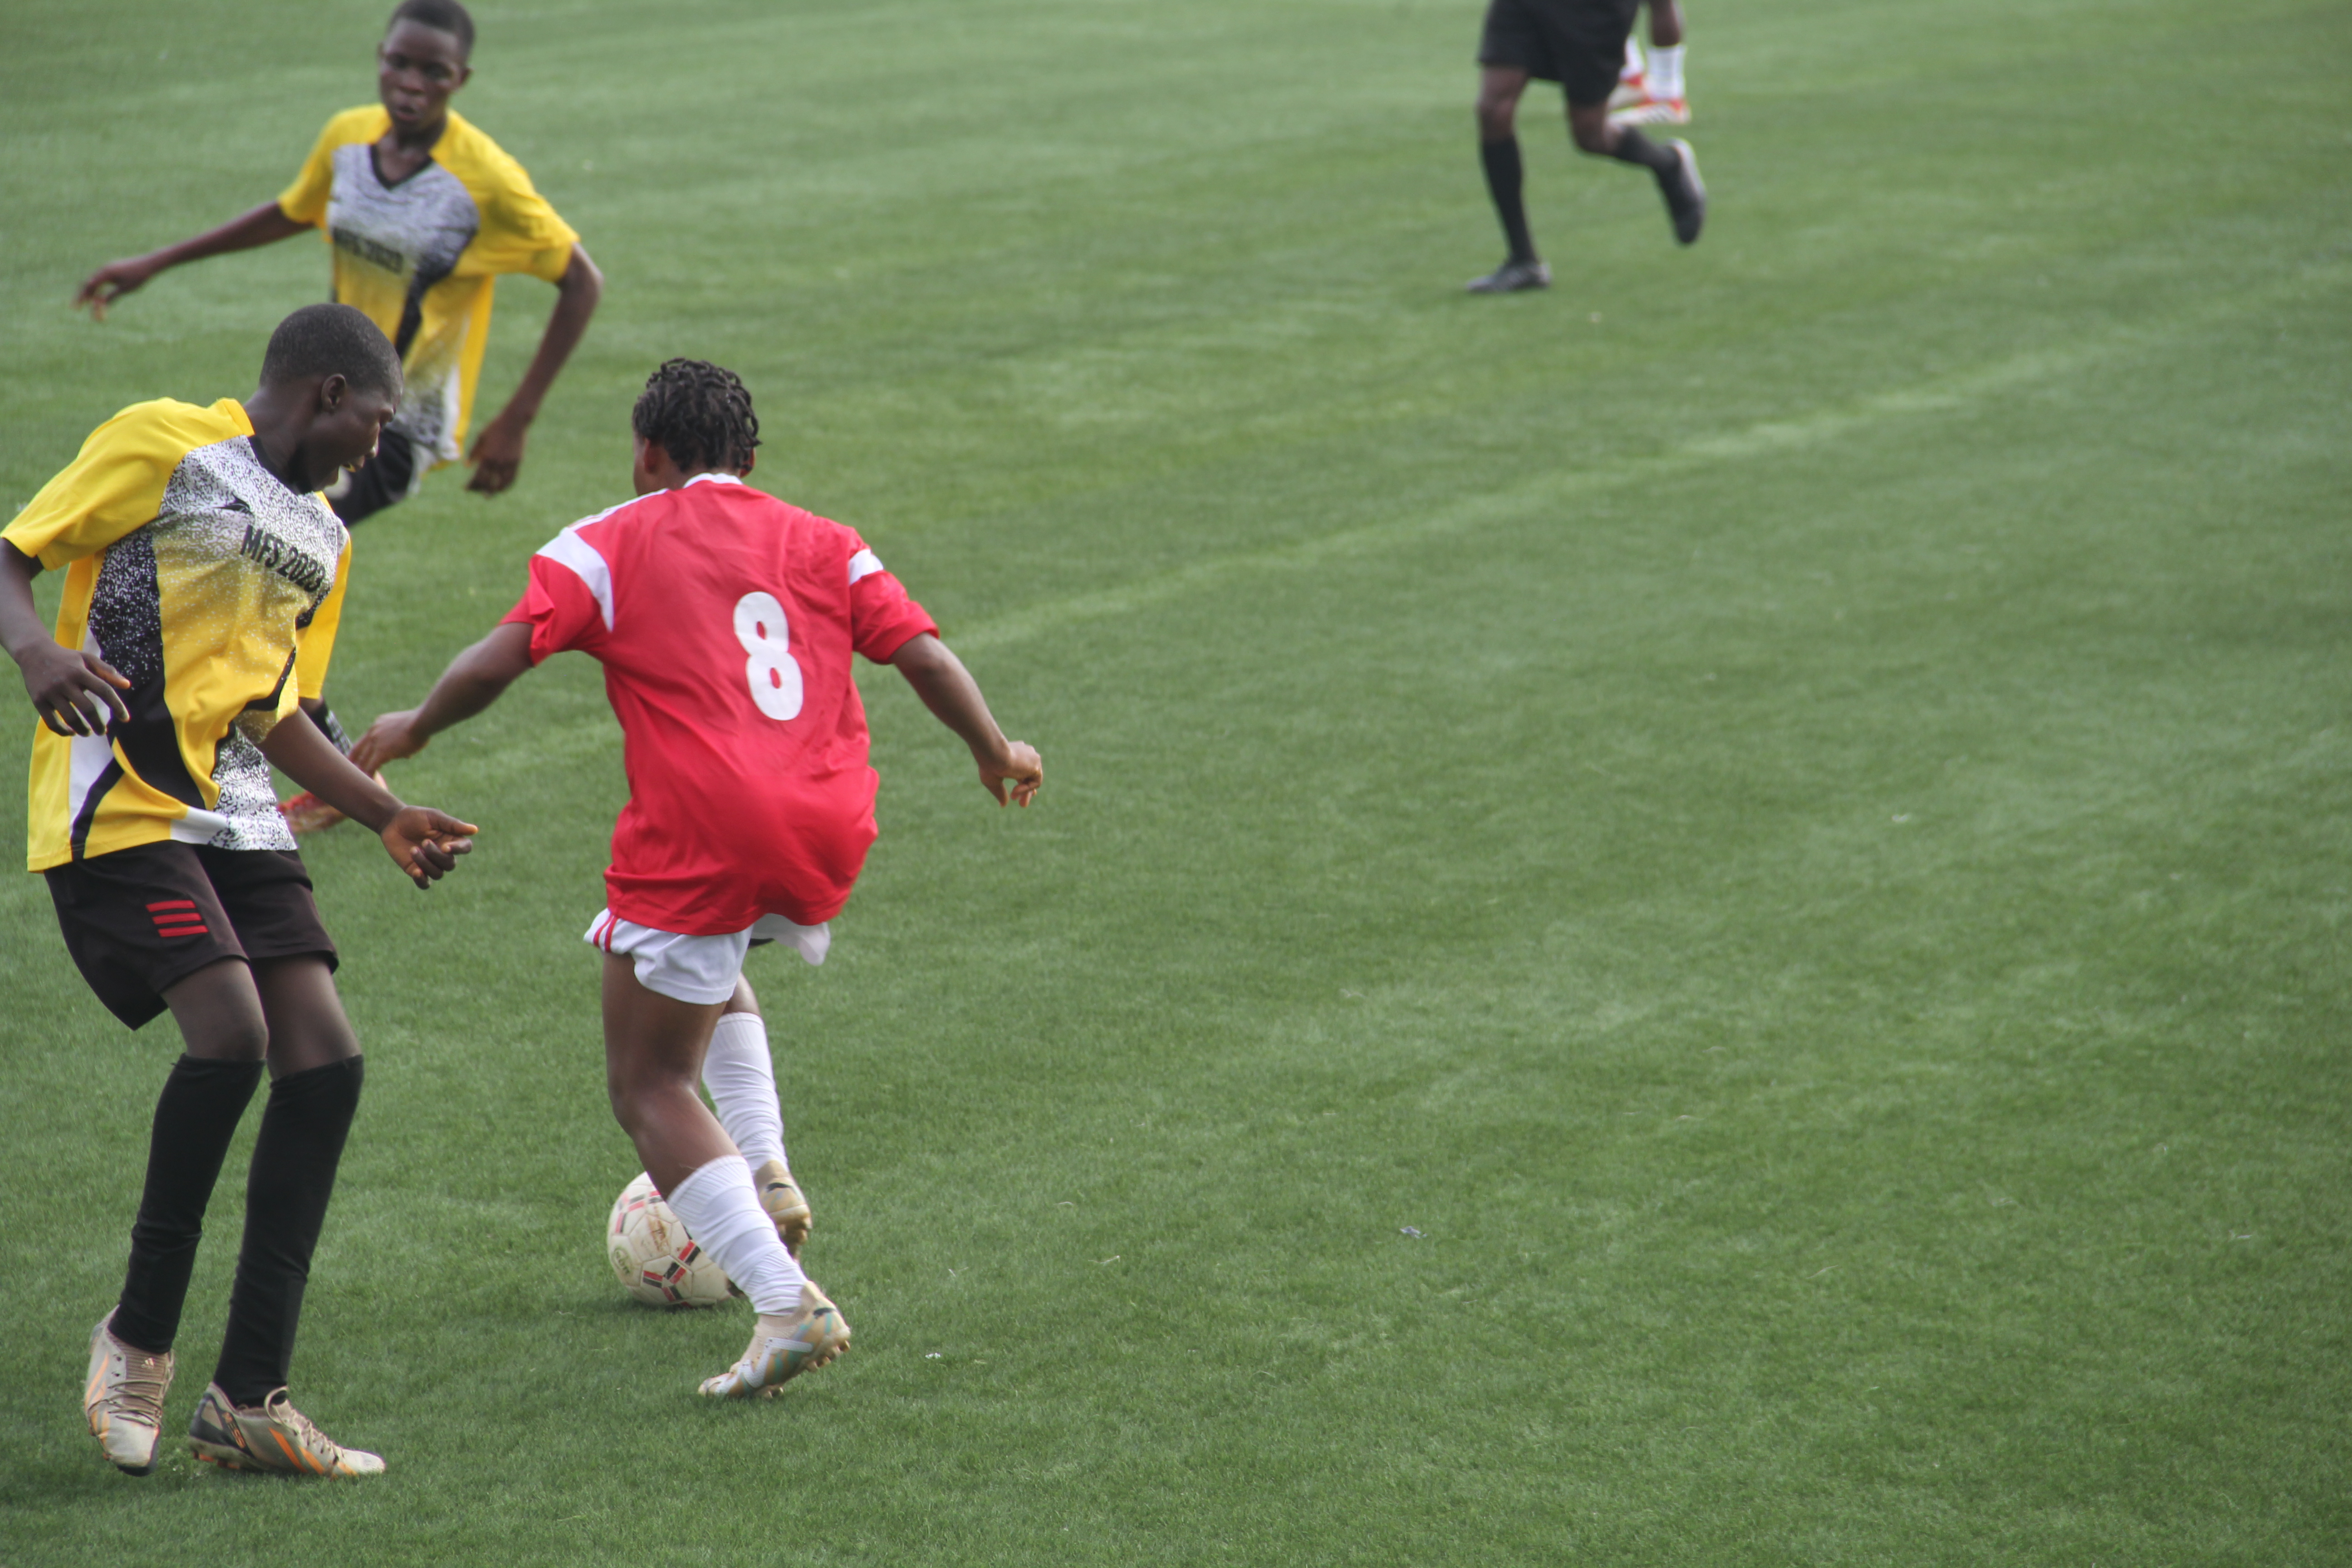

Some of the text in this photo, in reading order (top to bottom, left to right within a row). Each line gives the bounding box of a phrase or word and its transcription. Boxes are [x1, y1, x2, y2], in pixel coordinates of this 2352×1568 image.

[240, 525, 326, 593] MFS 2023
[733, 591, 803, 721] 8
